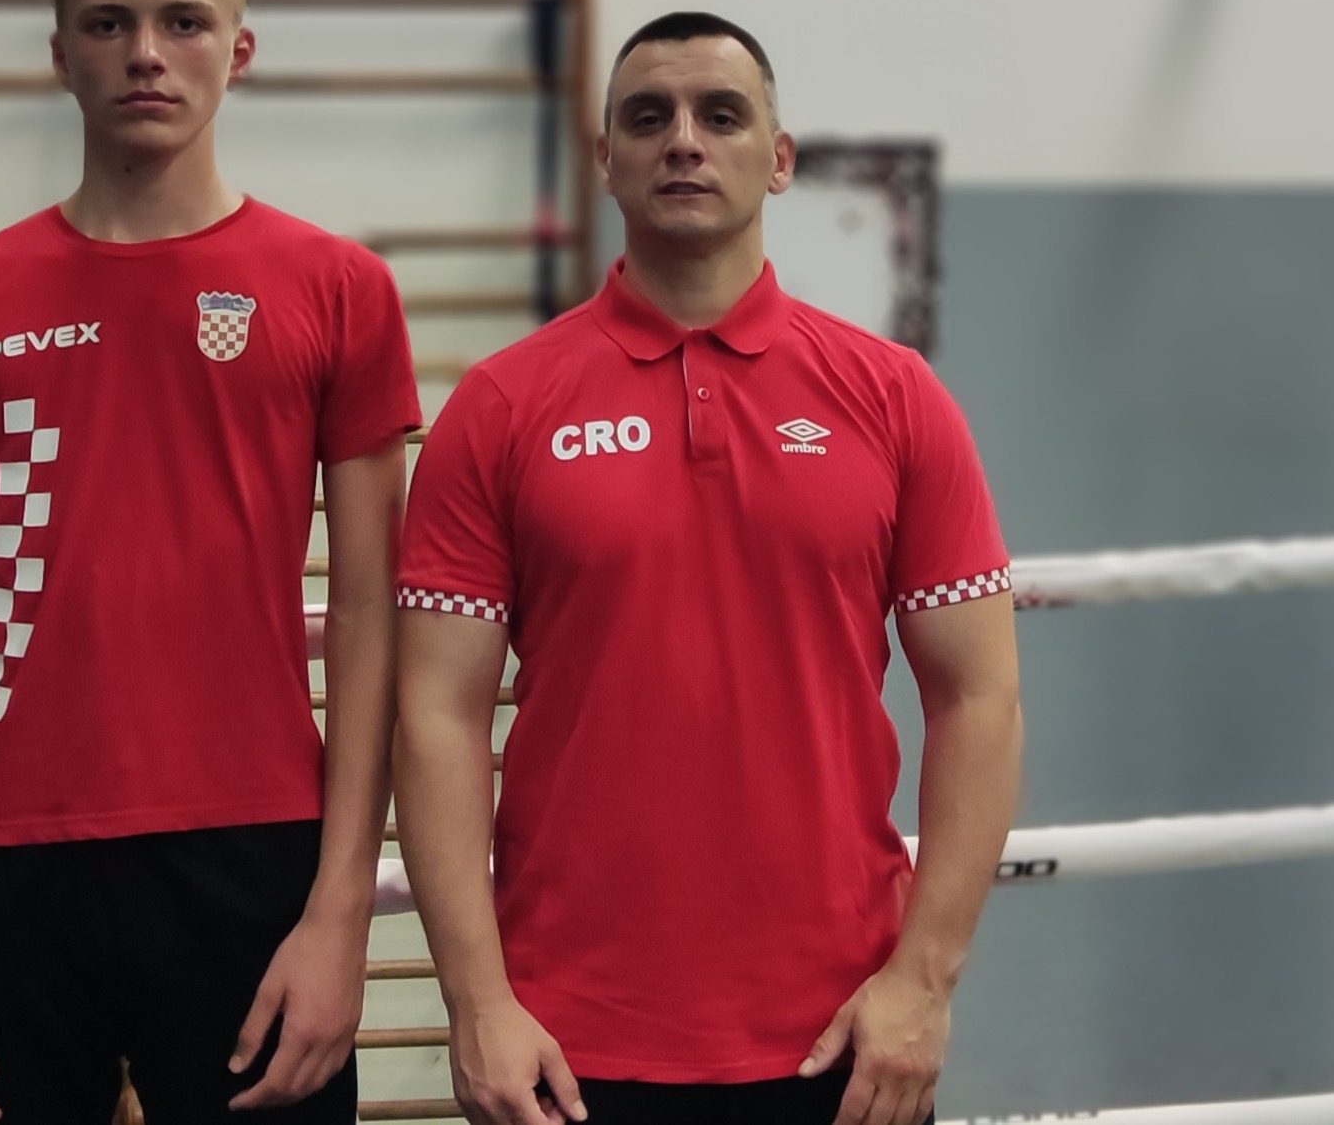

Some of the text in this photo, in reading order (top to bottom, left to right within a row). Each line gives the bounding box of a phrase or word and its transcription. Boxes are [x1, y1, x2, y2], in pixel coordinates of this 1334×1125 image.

[551, 416, 651, 460] CRO
[780, 441, 827, 455] umbro
[994, 860, 1058, 878] DO
